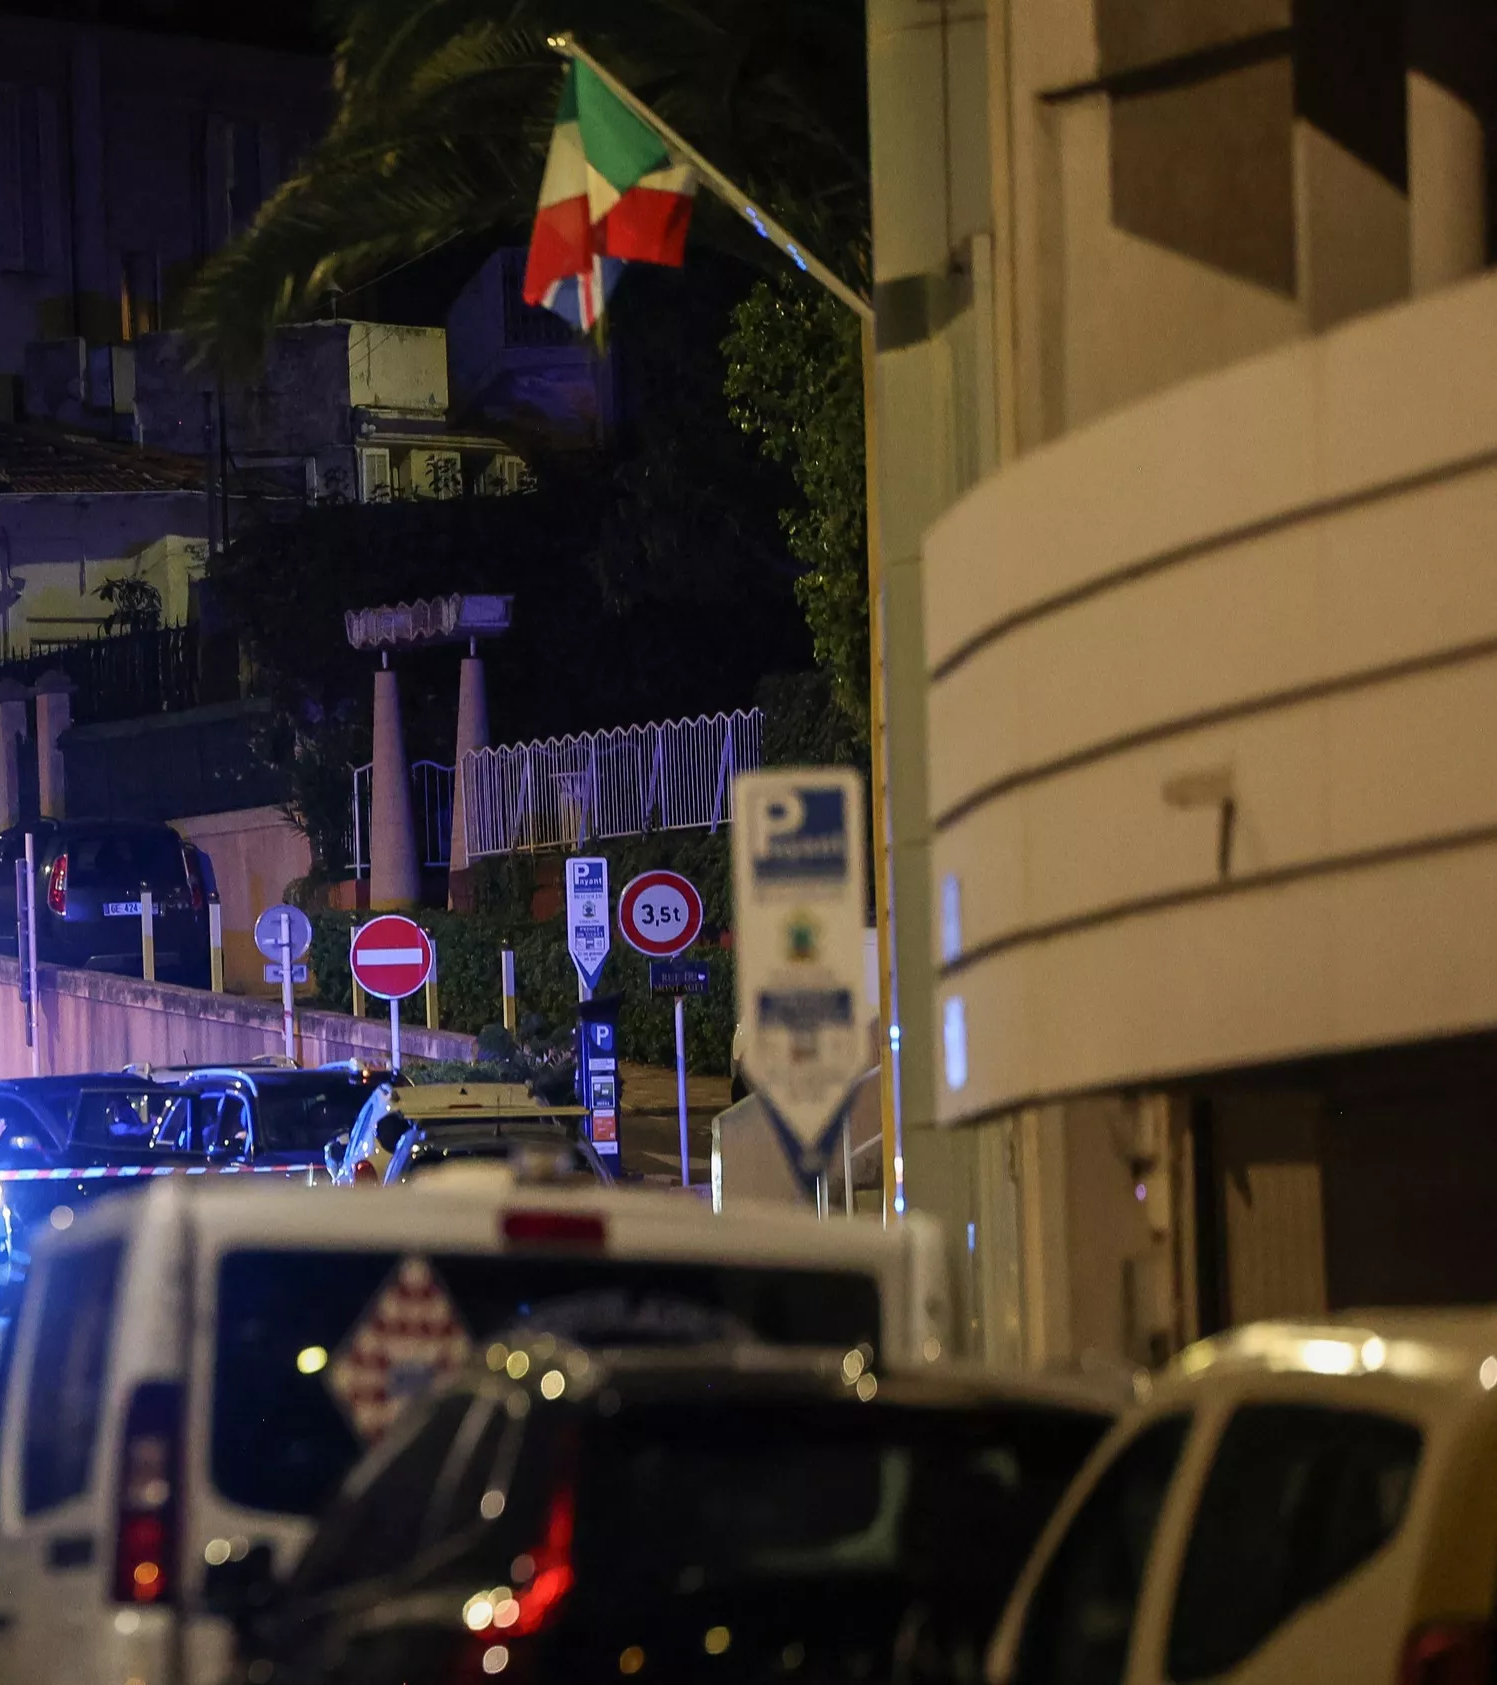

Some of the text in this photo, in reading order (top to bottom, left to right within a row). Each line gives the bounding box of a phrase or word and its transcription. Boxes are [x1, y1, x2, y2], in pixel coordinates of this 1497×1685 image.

[662, 971, 698, 982] RUE DU
[596, 1025, 610, 1046] P
